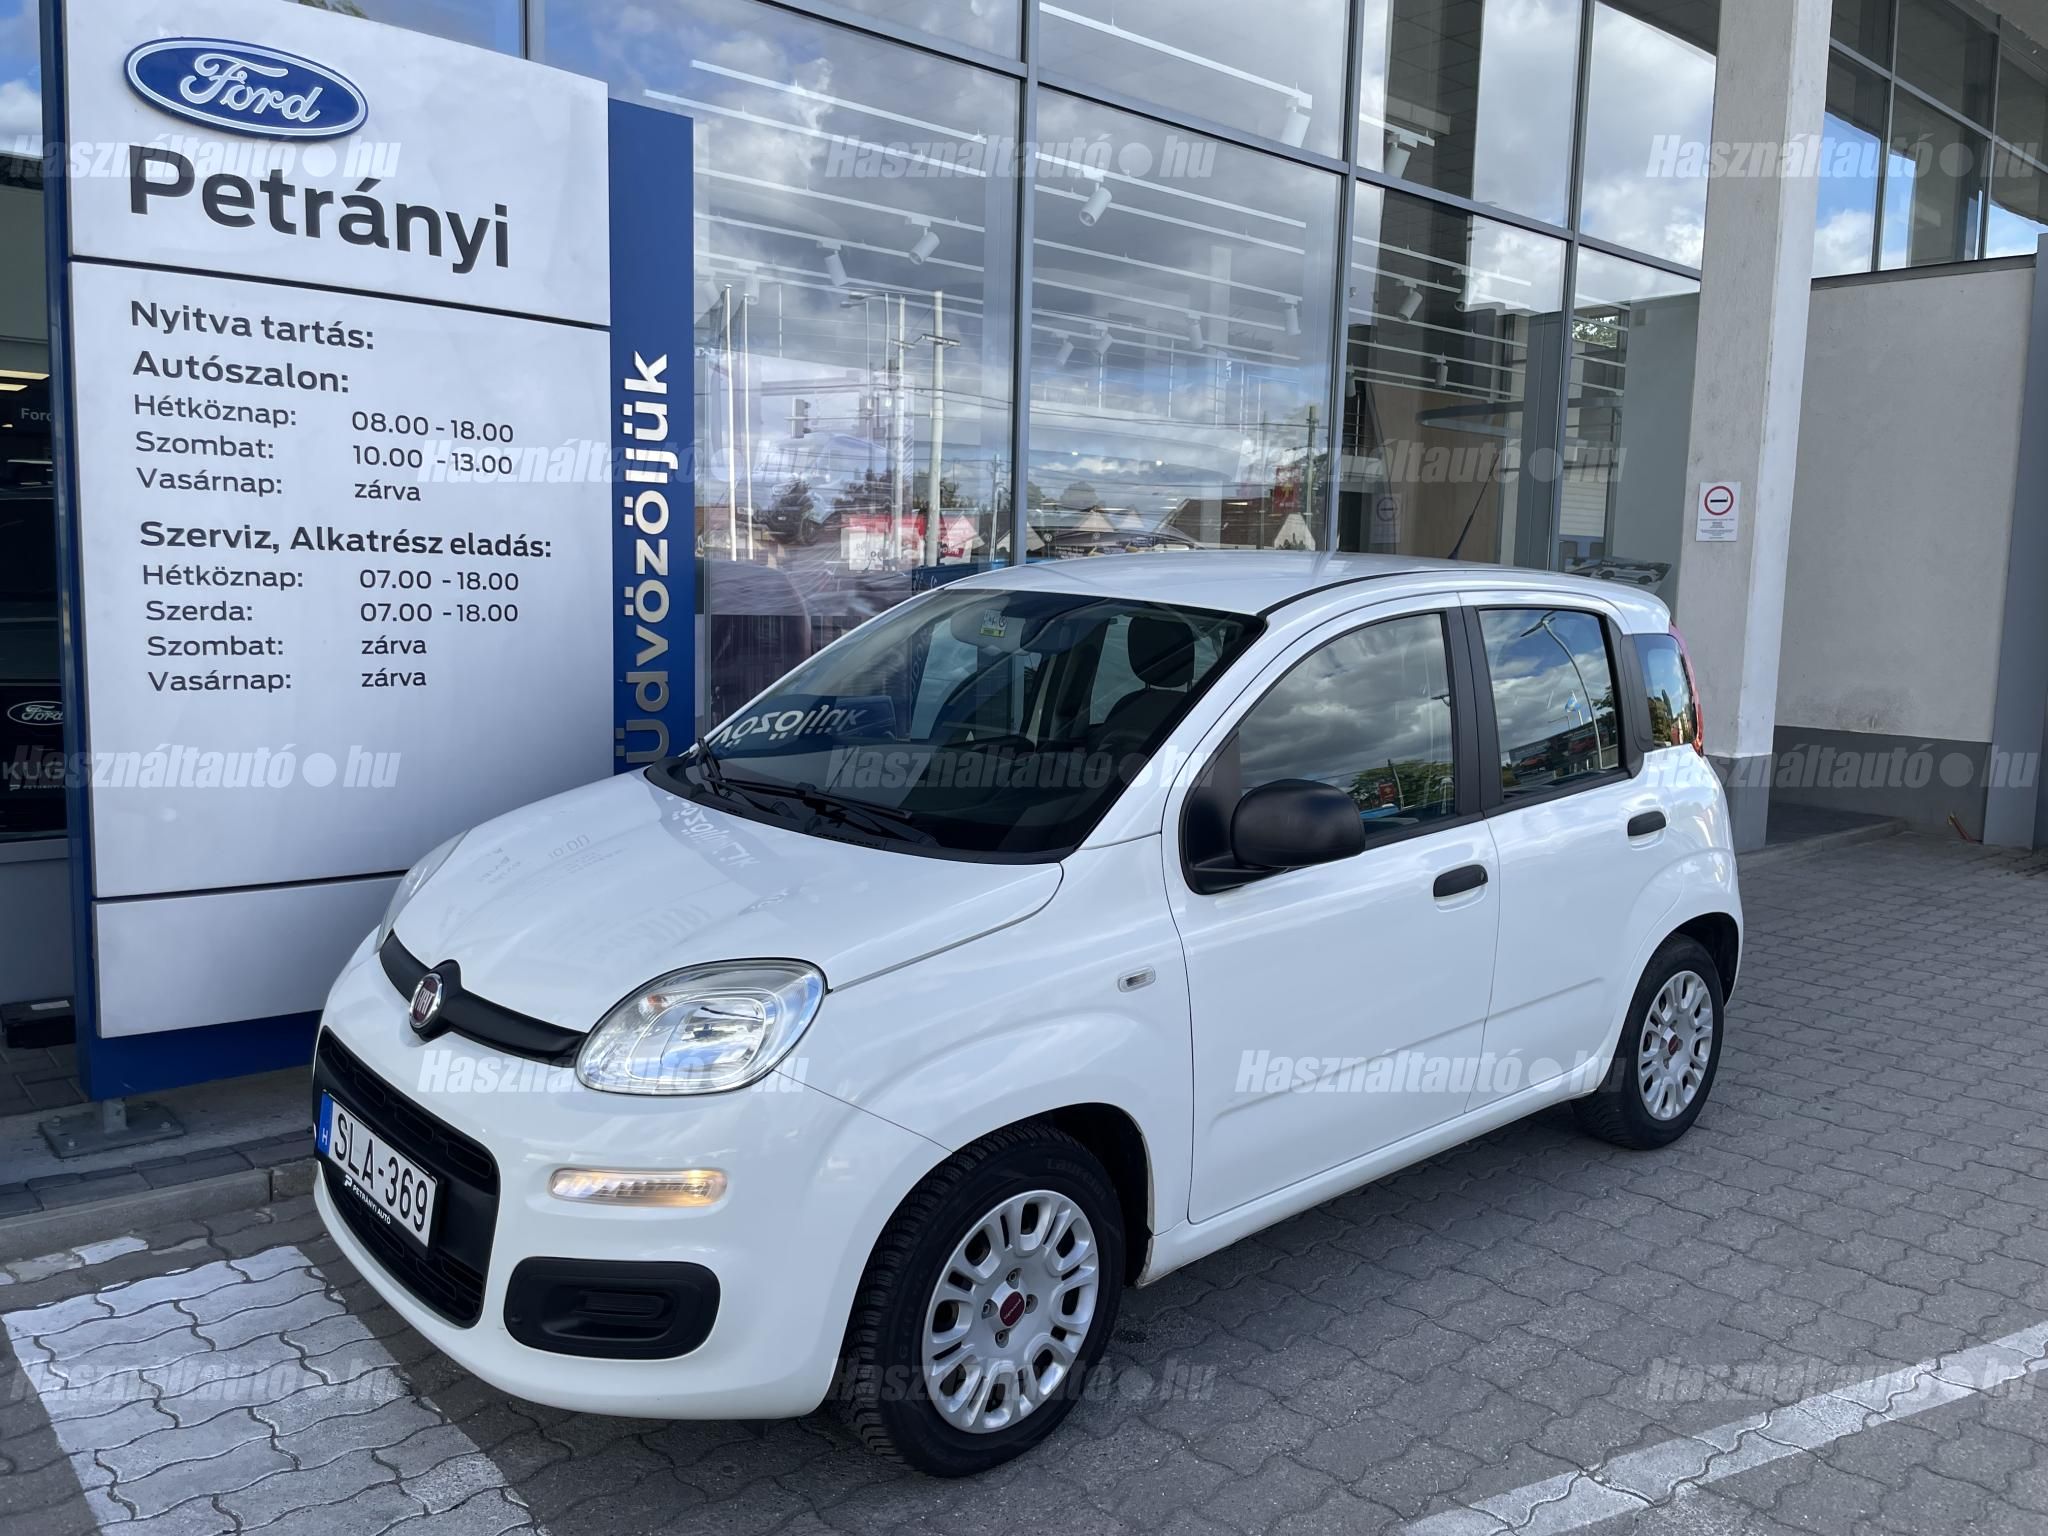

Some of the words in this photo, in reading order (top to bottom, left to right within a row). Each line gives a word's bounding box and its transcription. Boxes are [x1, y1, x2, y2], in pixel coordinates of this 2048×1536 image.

[178, 52, 324, 123] Ford
[128, 145, 509, 274] Petrányi
[131, 300, 252, 337] Nyitva
[261, 315, 374, 349] tartás:
[133, 350, 349, 393] Autószalon:
[134, 394, 296, 428] Hétköznap:
[352, 411, 429, 436] 08.00
[136, 431, 274, 459] Szombat:
[353, 445, 423, 469] 10.00
[136, 467, 282, 497] Vasárnap:
[354, 479, 421, 501] zárva
[140, 521, 280, 554] Szerviz,
[290, 526, 443, 554] Alkatrész
[450, 532, 551, 557] eladás:
[614, 351, 678, 763] Üdvözöljük
[143, 564, 303, 591] Hétköznap:
[360, 569, 432, 589] 07.00
[146, 600, 253, 621] Szerda:
[360, 603, 432, 622] 07.00
[147, 635, 283, 656] Szombat:
[361, 635, 427, 655] zárva
[148, 670, 291, 693] Vasárnap:
[361, 667, 427, 687] zárva
[321, 1130, 328, 1146] H
[334, 1112, 429, 1232] SLA-369
